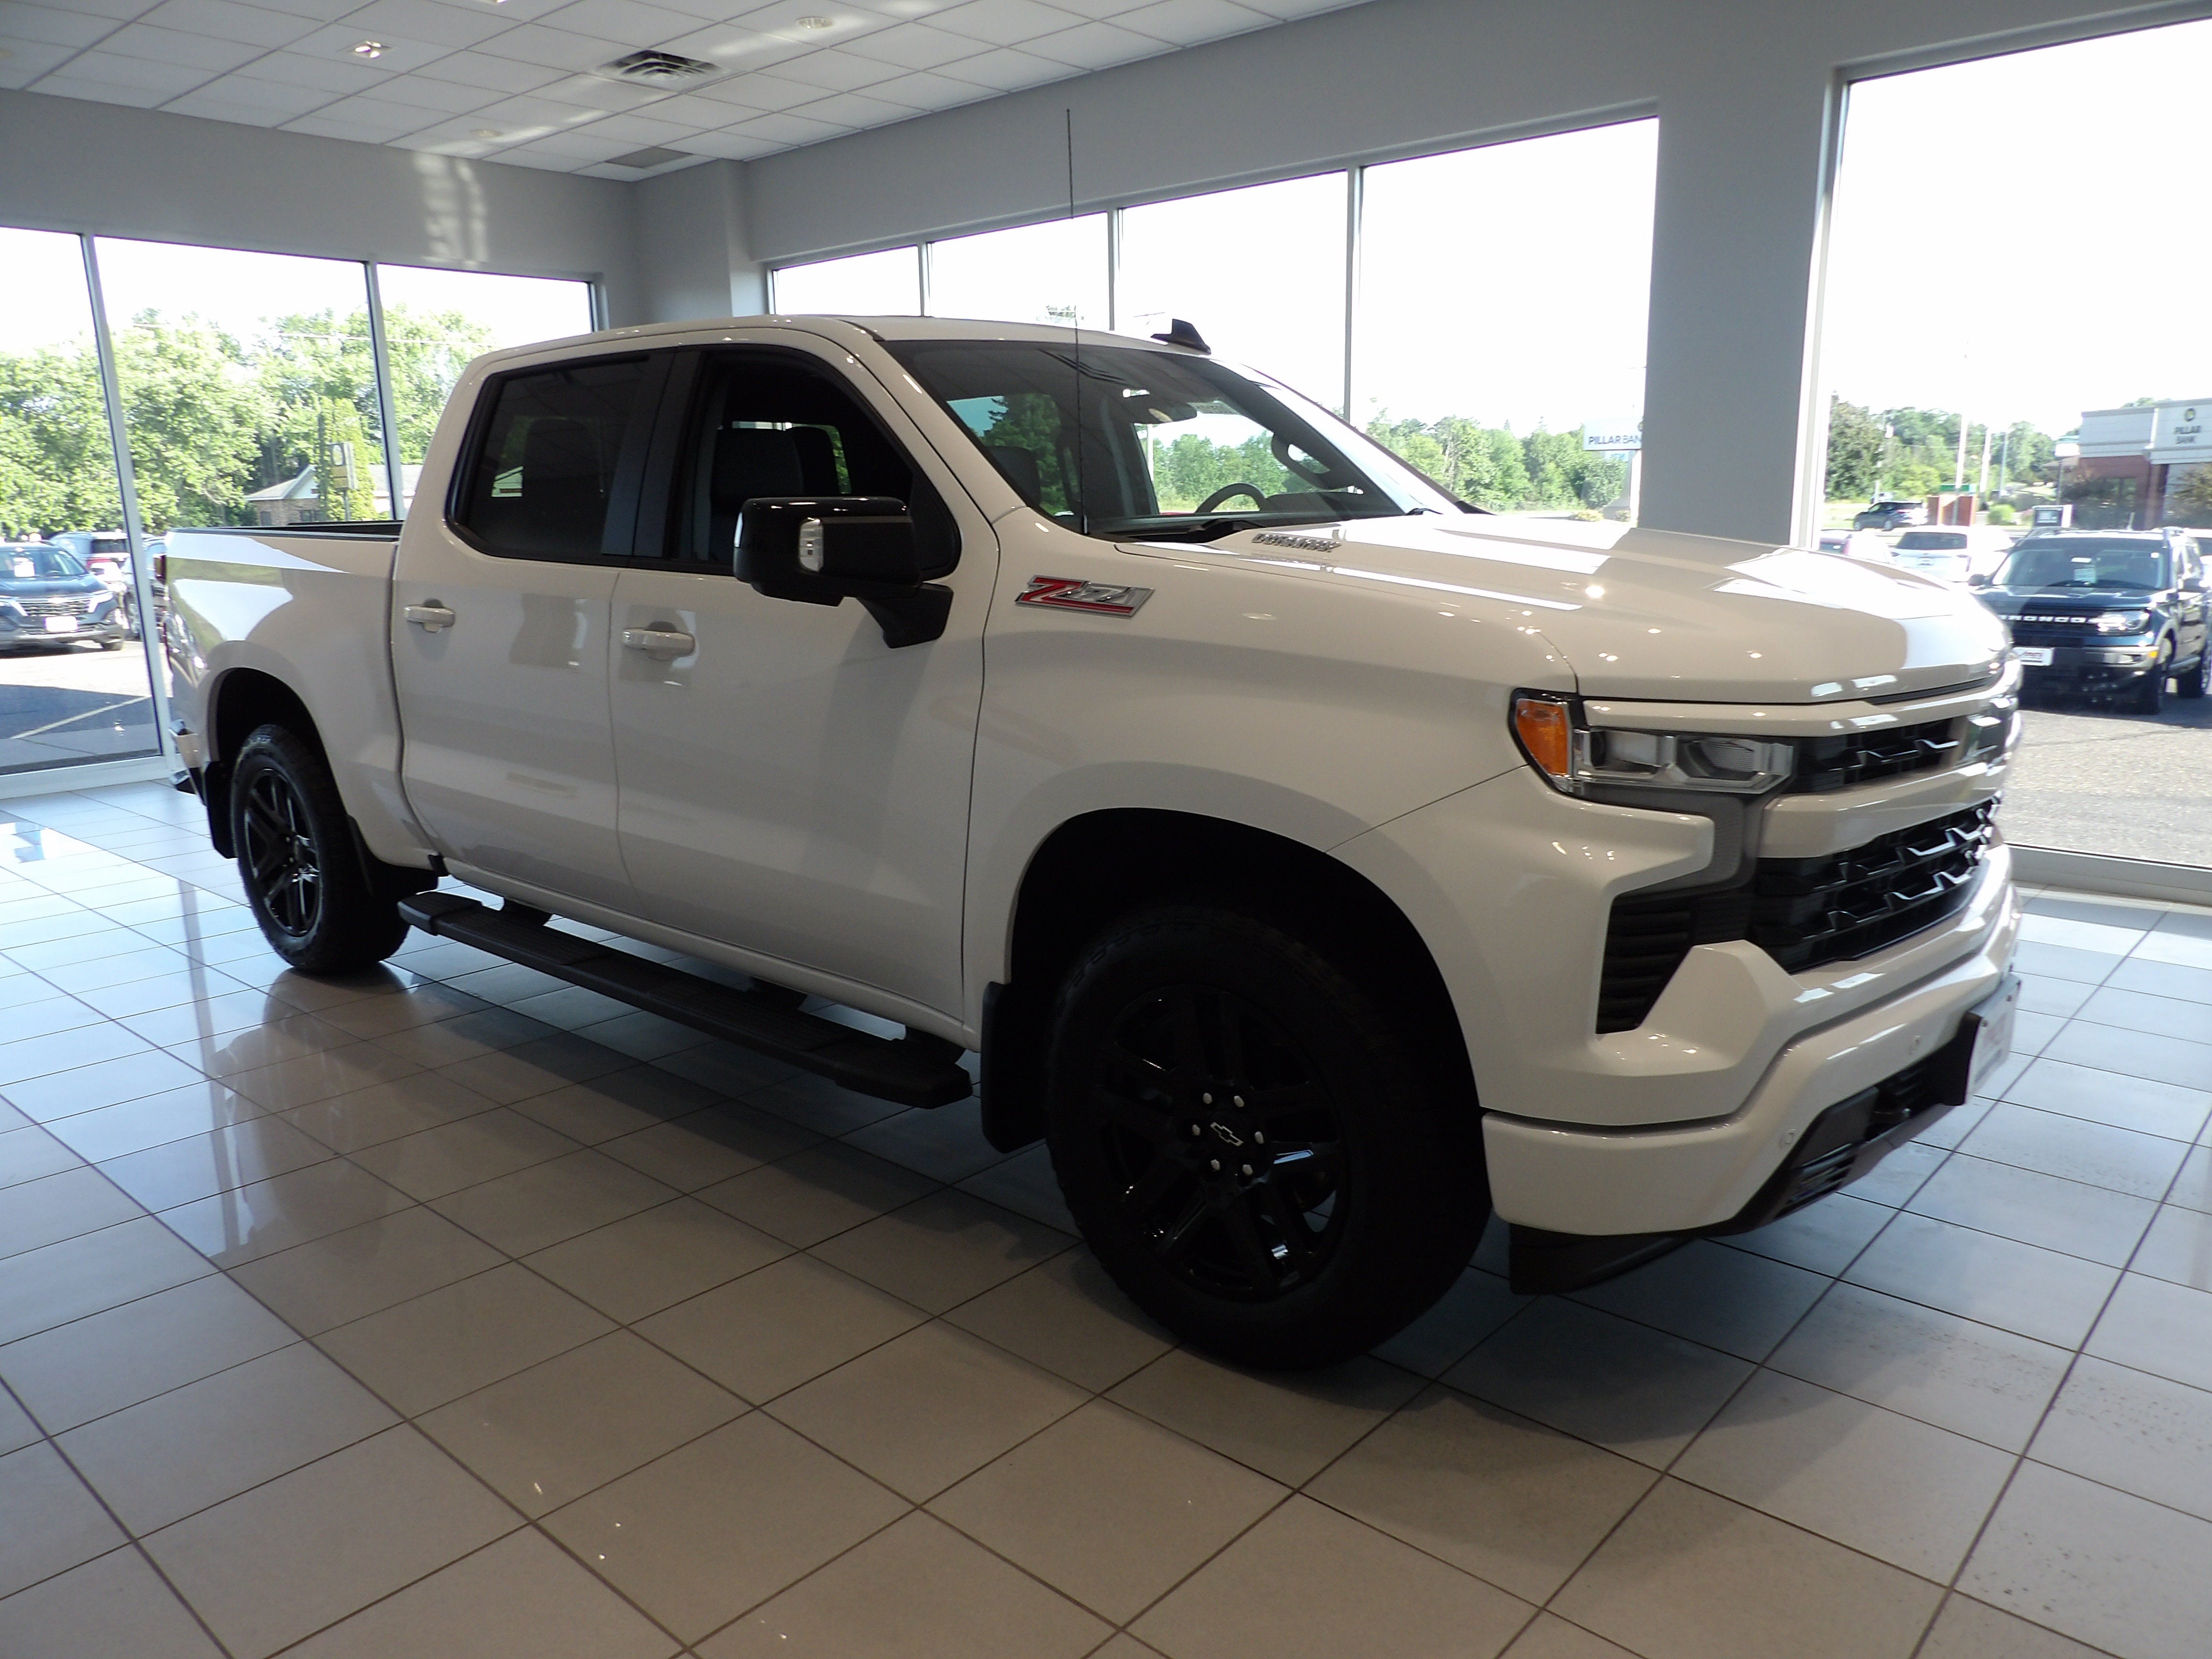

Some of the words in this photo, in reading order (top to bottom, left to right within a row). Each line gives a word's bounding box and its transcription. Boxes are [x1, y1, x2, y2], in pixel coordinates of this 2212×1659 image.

[1588, 435, 1621, 445] PILLAR
[1623, 435, 1641, 444] BAN
[1251, 533, 1342, 553] DURAMAX
[1015, 575, 1155, 617] Z71
